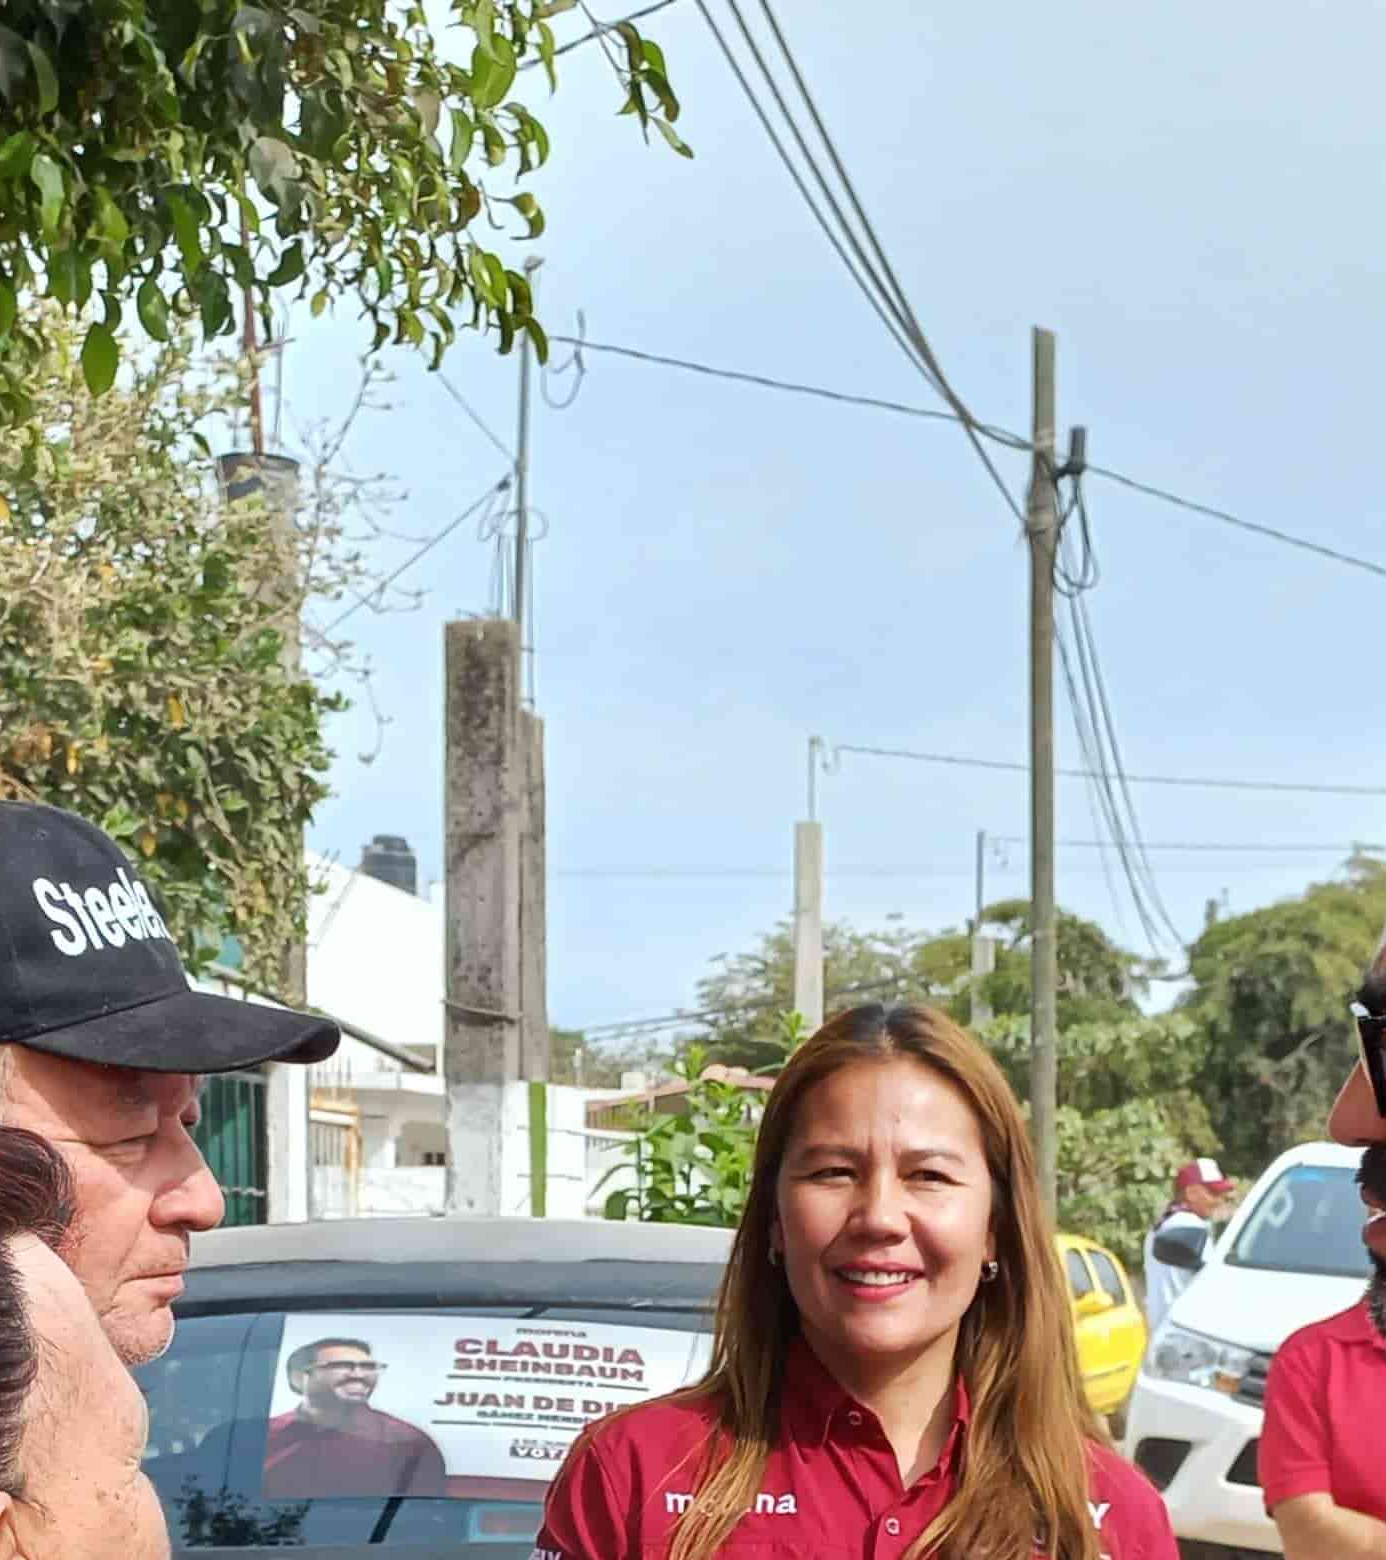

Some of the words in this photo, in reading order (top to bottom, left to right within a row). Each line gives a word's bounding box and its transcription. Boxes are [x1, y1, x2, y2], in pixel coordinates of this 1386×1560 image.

[454, 1338, 645, 1366] CLAUDIA
[453, 1358, 644, 1382] SHEINBAUM
[434, 1391, 525, 1409] JUAN
[533, 1395, 575, 1413] DE
[665, 1491, 797, 1515] mna
